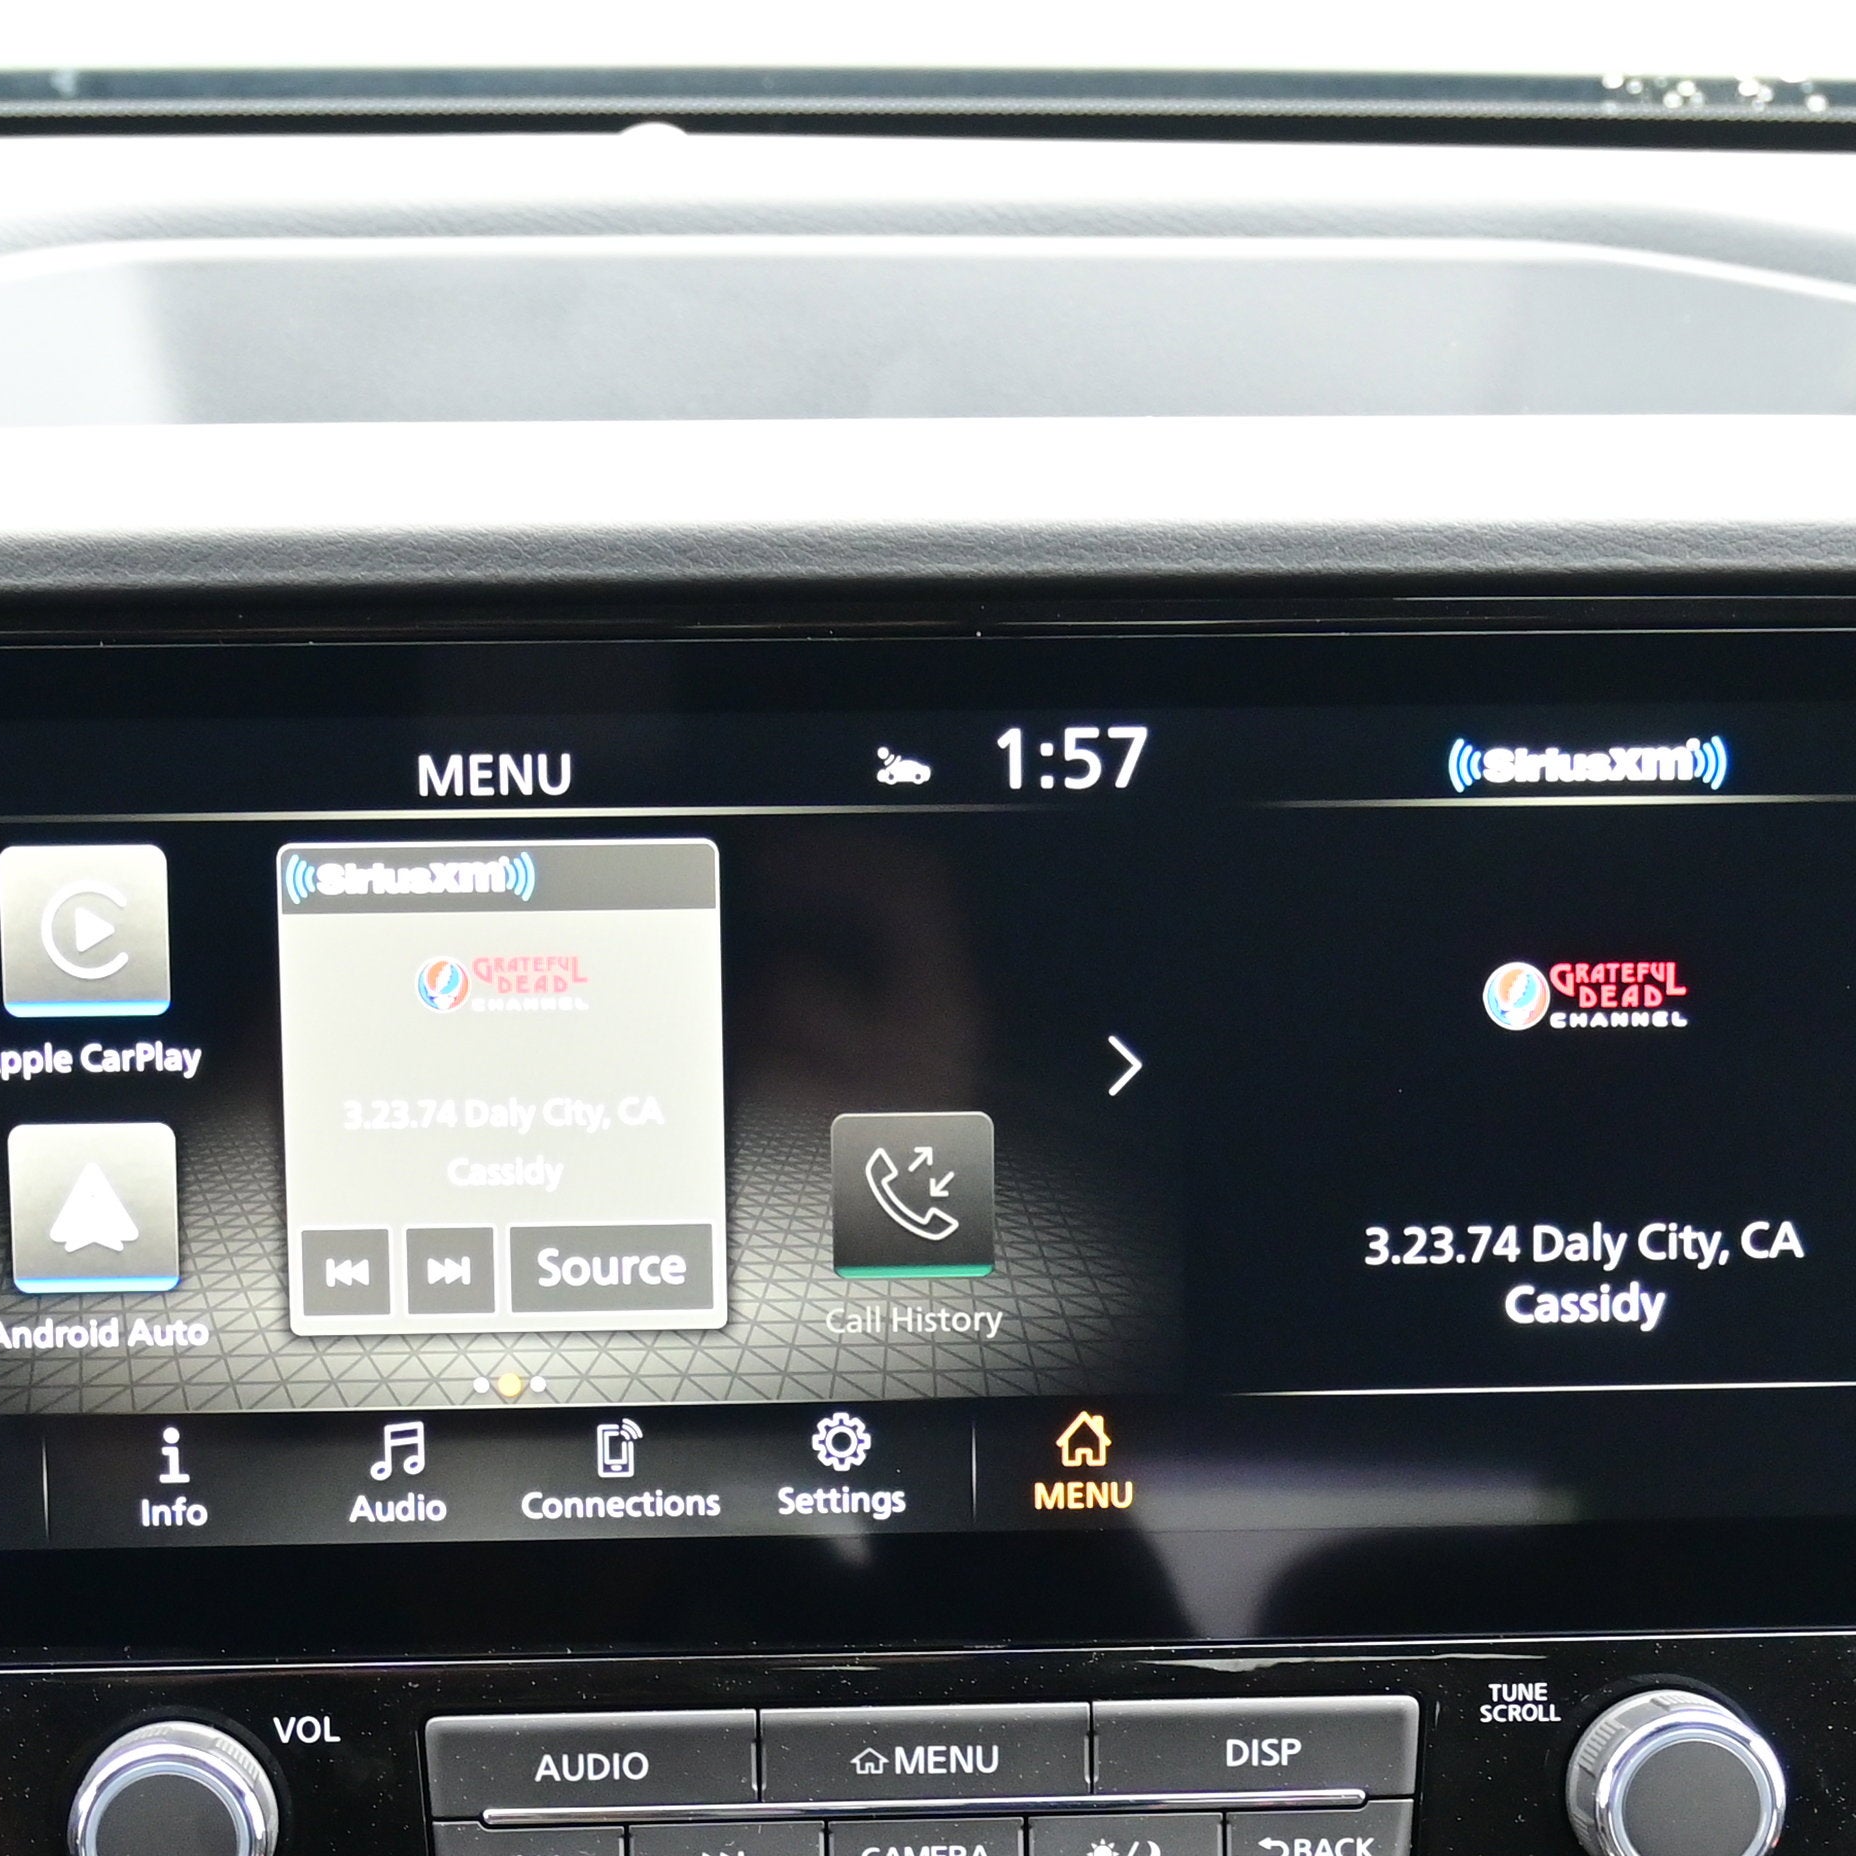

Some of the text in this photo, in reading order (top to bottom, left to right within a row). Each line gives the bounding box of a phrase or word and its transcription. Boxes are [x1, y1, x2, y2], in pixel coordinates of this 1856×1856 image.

[997, 725, 1148, 791] 1:57
[417, 752, 572, 797] MENU
[472, 956, 589, 985] GRATEFUL
[497, 975, 568, 994] DEAD
[1549, 962, 1688, 997] GRATEFUL
[1578, 984, 1664, 1008] DEAD
[1549, 1011, 1689, 1029] CHANNEL
[79, 1040, 203, 1078] CarPlay
[343, 1095, 665, 1135] 3.23.74 Daly City, CA
[447, 1155, 565, 1192] Cassidy
[1364, 1221, 1805, 1272] 3.23.74 Daly City, CA
[537, 1248, 687, 1288] Source
[825, 1304, 1004, 1339] Call History
[1504, 1281, 1667, 1332] Cassidy
[127, 1319, 210, 1348] Auto
[141, 1496, 208, 1527] Info
[349, 1493, 448, 1523] Audio
[521, 1489, 721, 1521] Connections
[777, 1485, 907, 1520] Settings
[1033, 1480, 1134, 1512] MENU
[1488, 1682, 1548, 1702] TUNE
[1479, 1701, 1561, 1724] SCROLL
[272, 1715, 341, 1745] VOL
[534, 1751, 649, 1783] AUDIO
[894, 1744, 999, 1776] MENU
[1225, 1738, 1303, 1768] DISP
